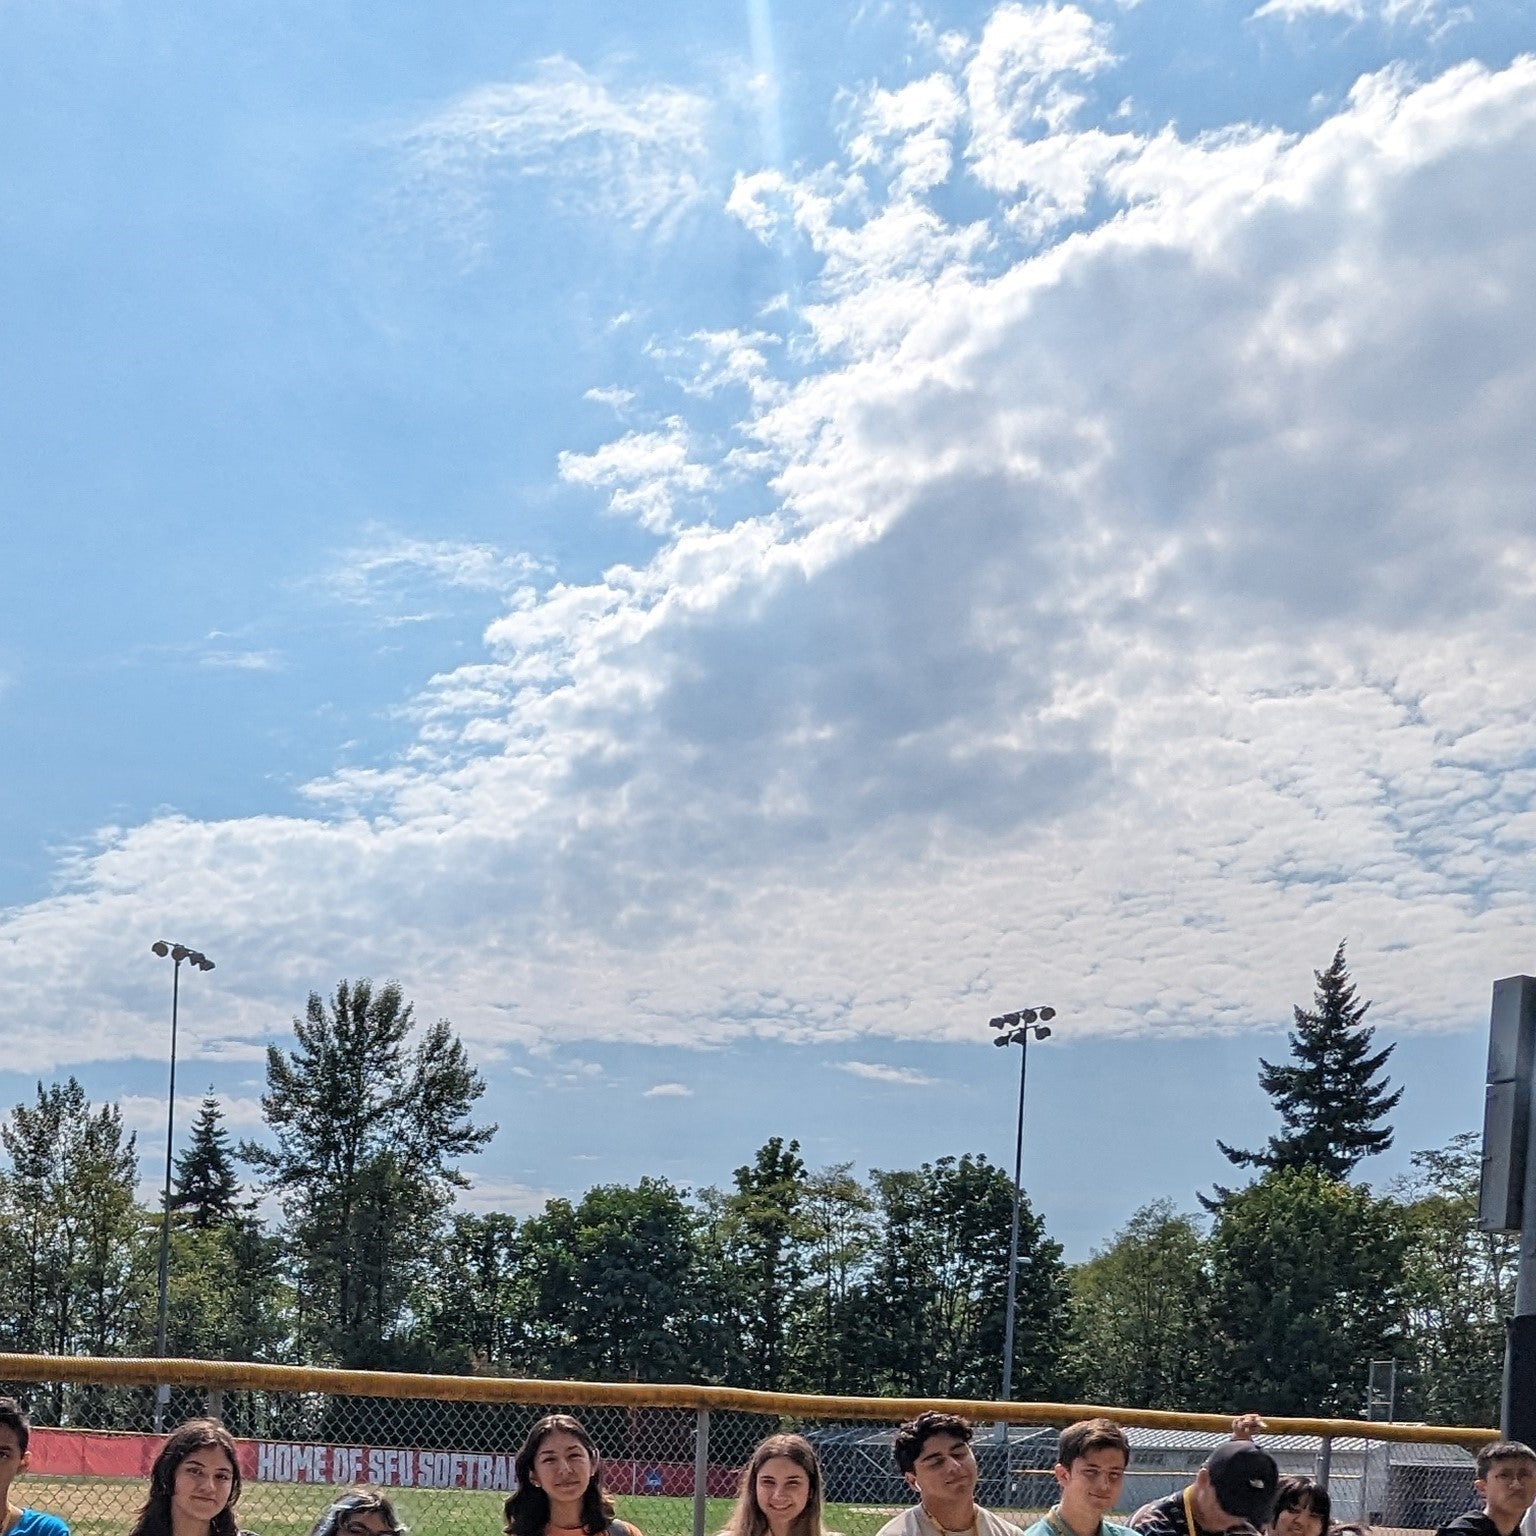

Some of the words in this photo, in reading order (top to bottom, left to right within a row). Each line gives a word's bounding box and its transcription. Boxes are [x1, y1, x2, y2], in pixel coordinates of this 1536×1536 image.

[257, 1443, 327, 1483] HOME
[332, 1447, 363, 1485] OF
[369, 1449, 413, 1487] SFU
[418, 1452, 518, 1490] SOFTBAL
